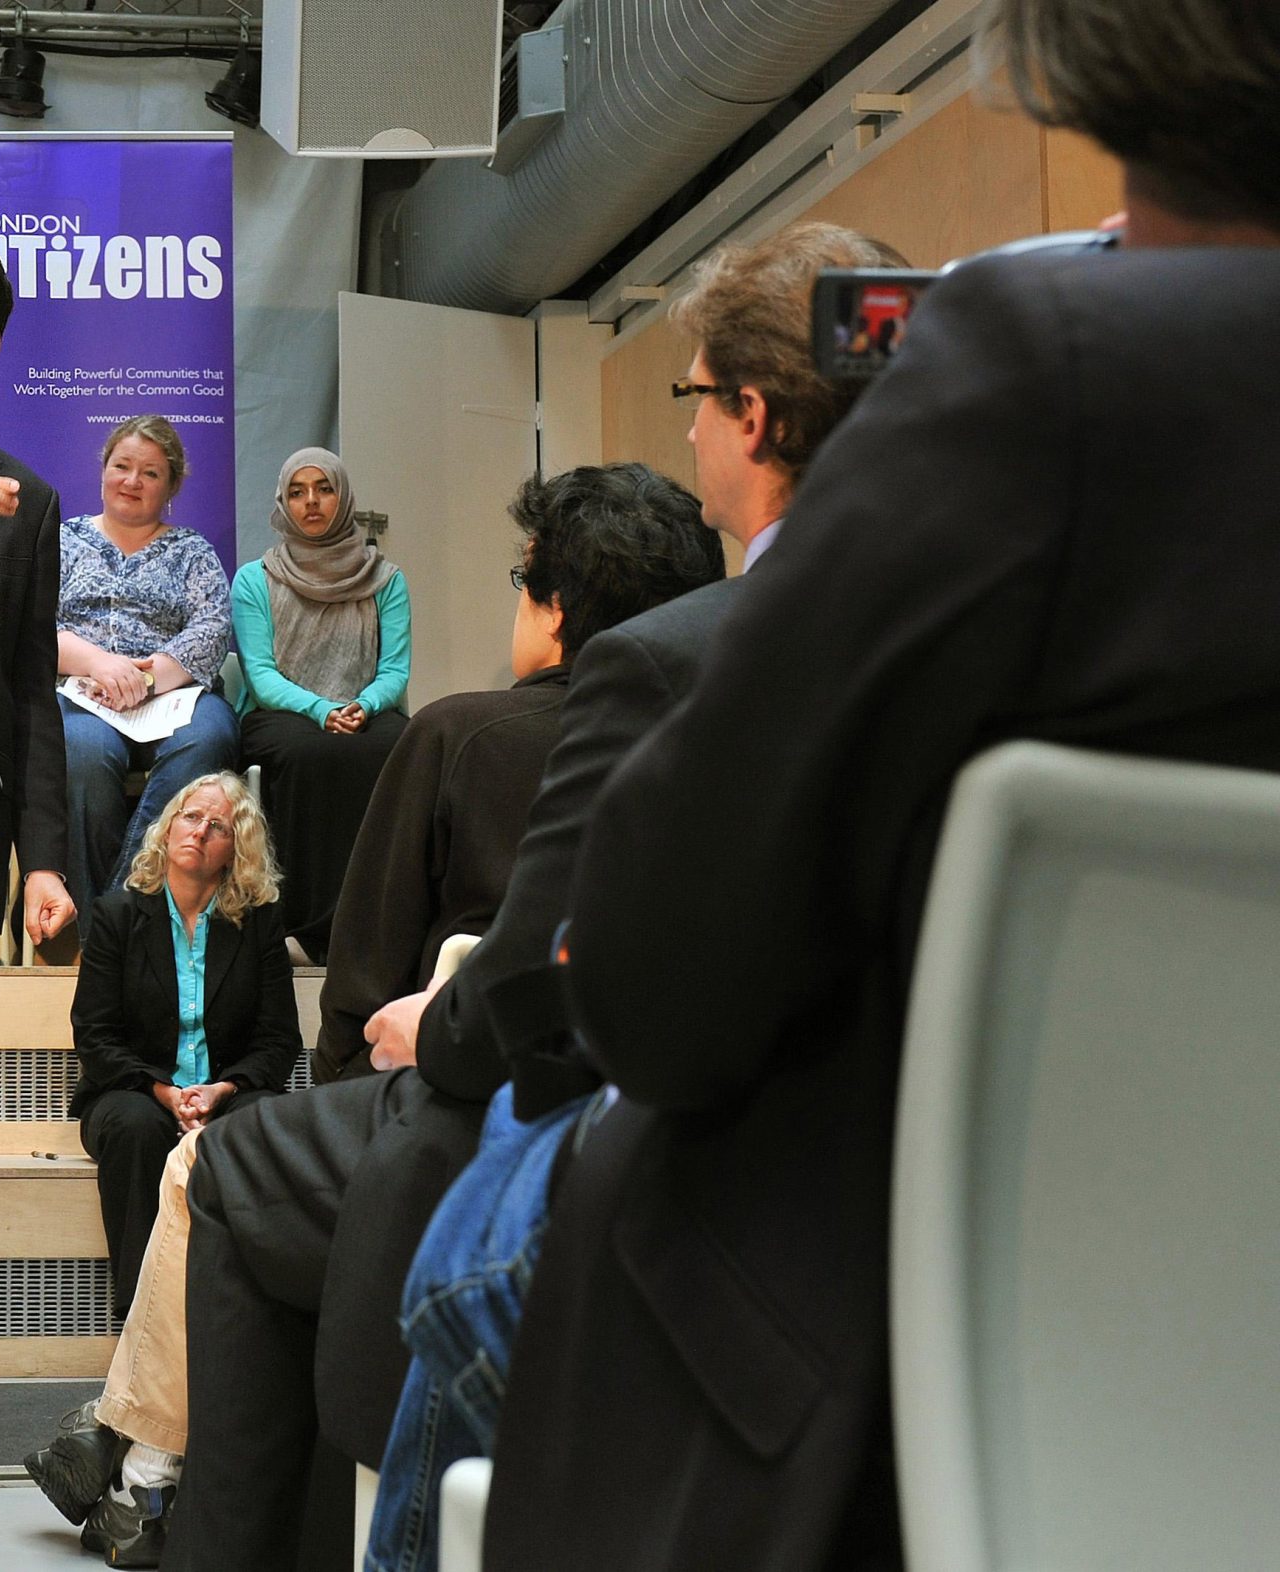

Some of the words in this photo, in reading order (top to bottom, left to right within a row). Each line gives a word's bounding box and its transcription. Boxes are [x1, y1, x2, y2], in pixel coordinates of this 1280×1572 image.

[28, 367, 71, 382] Building
[74, 367, 122, 379] Powerful
[125, 367, 200, 379] Communities
[203, 368, 224, 380] that
[13, 383, 46, 396] Work
[46, 383, 95, 399] Together
[97, 384, 114, 396] for
[116, 384, 134, 396] the
[137, 383, 190, 396] Common
[192, 384, 224, 397] Good
